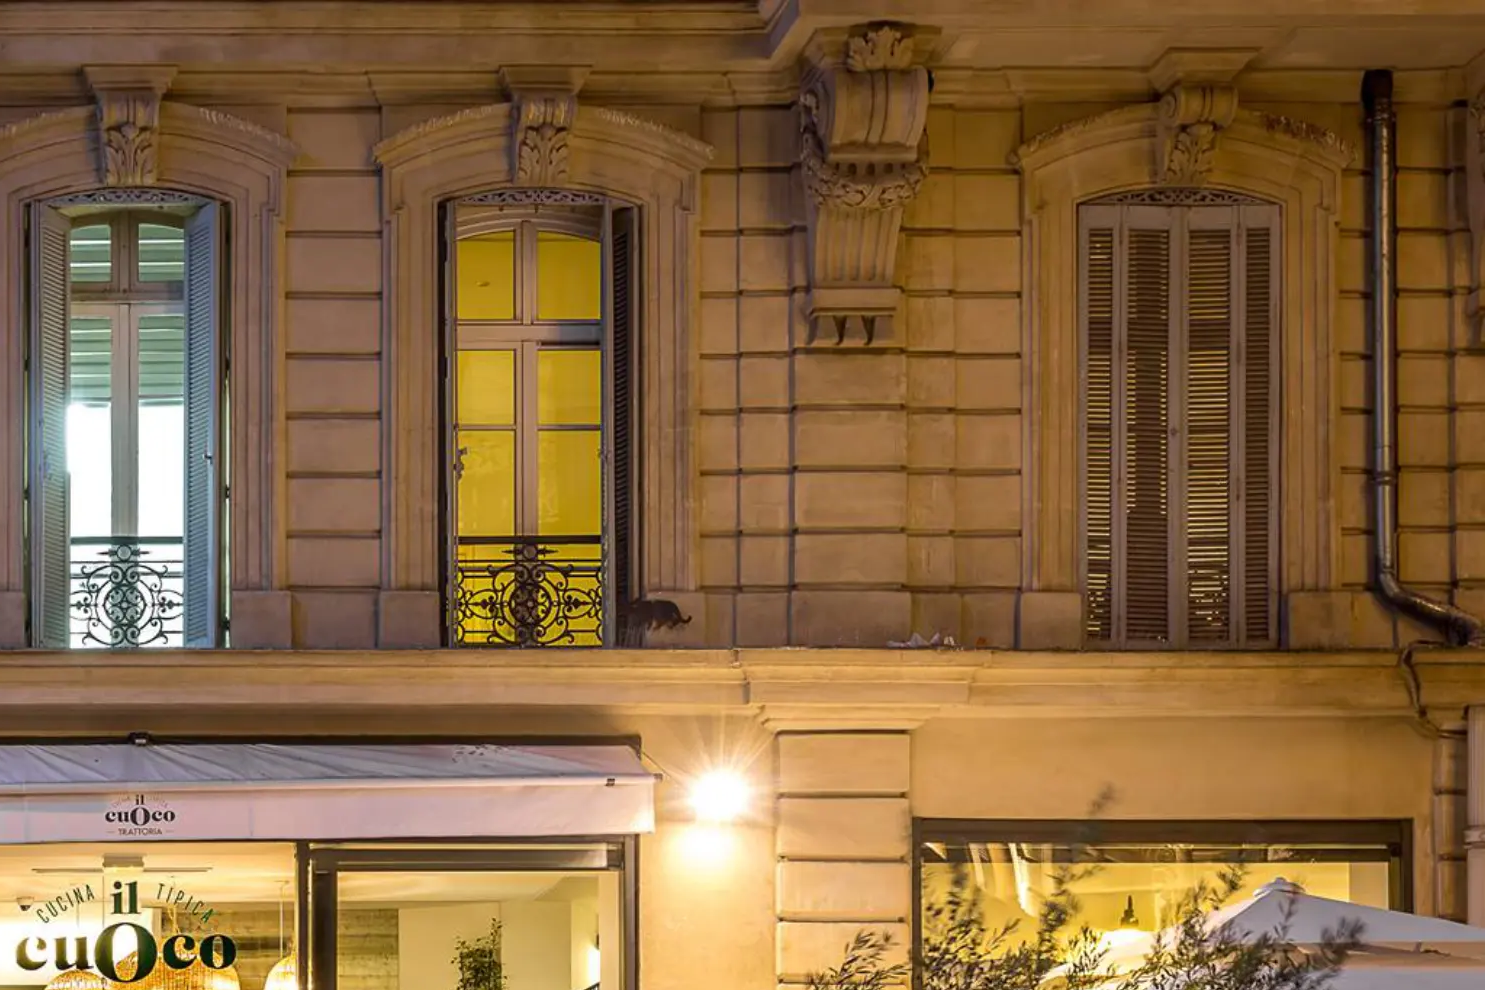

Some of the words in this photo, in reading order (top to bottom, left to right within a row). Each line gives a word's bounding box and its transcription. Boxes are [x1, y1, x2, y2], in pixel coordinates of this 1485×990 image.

[135, 794, 145, 805] il
[105, 806, 176, 826] cuOco
[118, 828, 163, 836] TRATTORIA
[36, 884, 96, 924] CUCINA
[156, 883, 215, 924] TIPICA
[110, 881, 141, 915] il
[16, 921, 237, 983] cuOco
